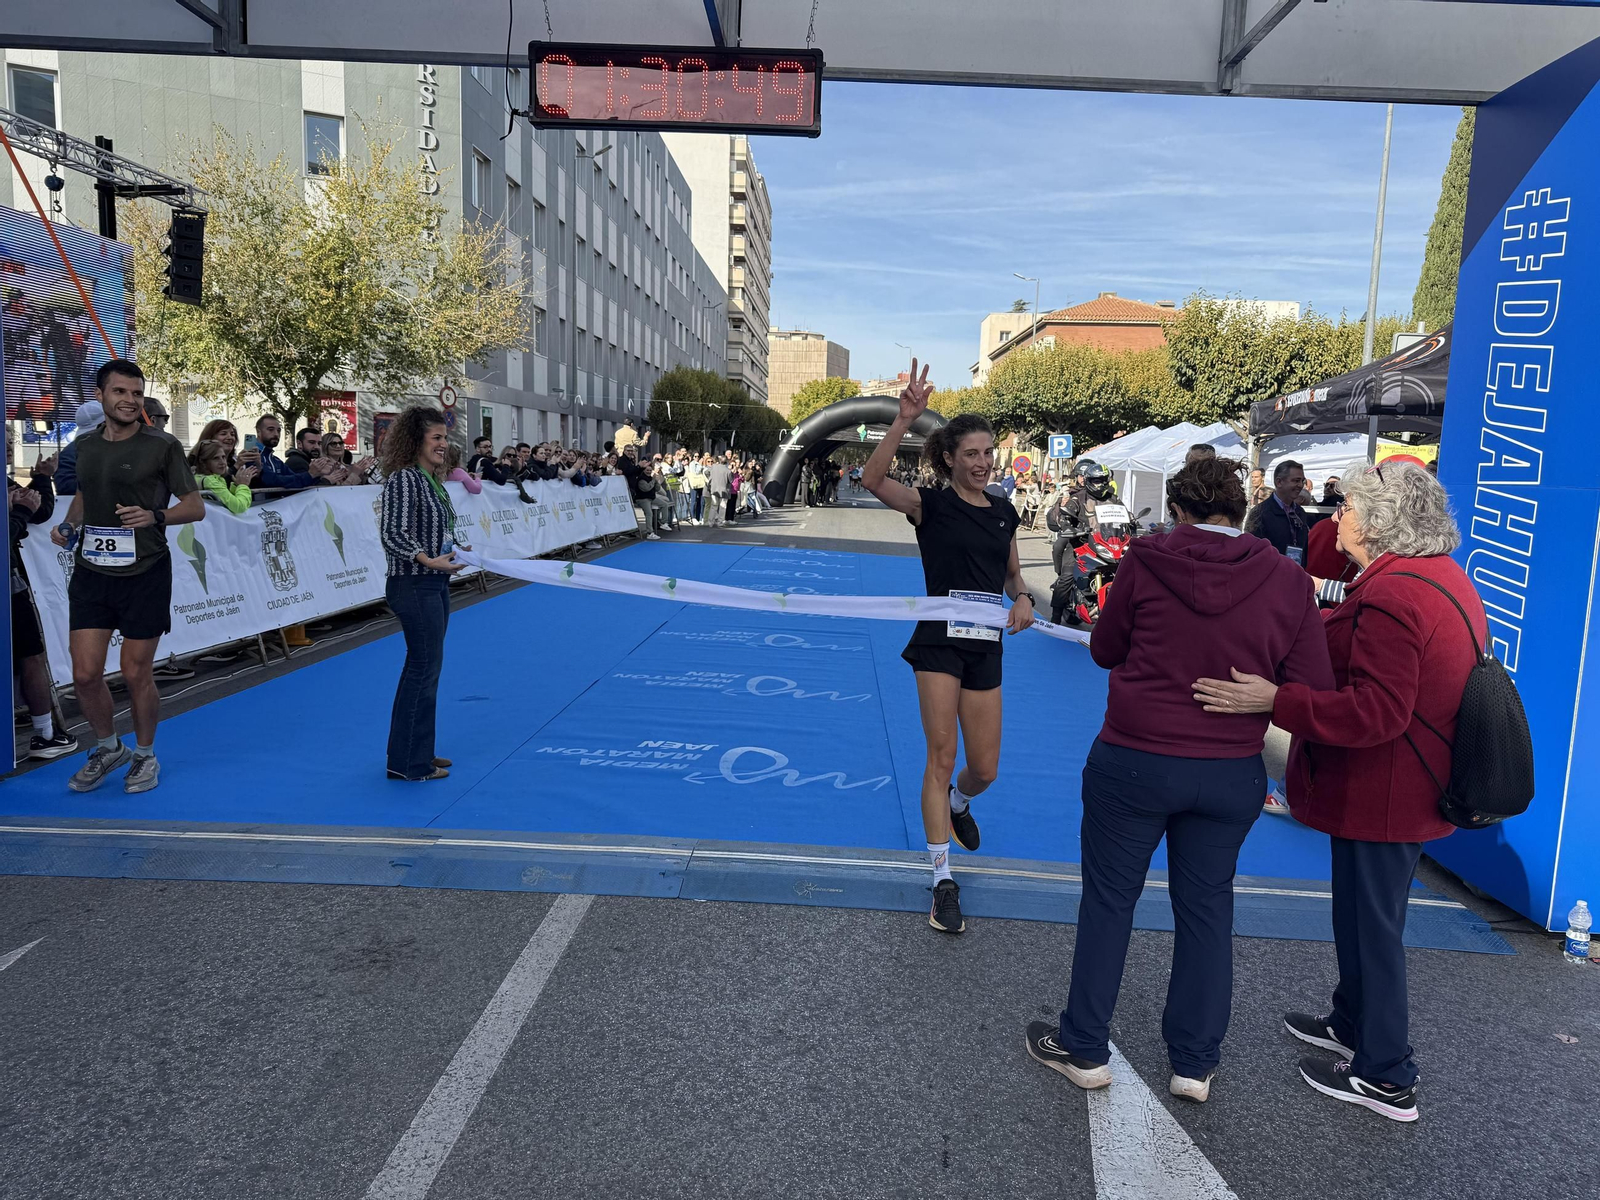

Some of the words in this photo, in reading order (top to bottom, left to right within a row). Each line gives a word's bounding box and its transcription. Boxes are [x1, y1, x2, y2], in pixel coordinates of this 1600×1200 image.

[1465, 187, 1571, 678] #DEJAHUE
[1053, 438, 1067, 455] P
[94, 538, 117, 552] 28
[173, 599, 206, 614] Patronato
[206, 594, 235, 608] Municipal
[237, 593, 245, 602] de
[267, 597, 291, 610] CIUDAD
[290, 594, 300, 604] DE
[300, 590, 314, 602] JAÉN
[185, 611, 216, 625] Deportes
[216, 608, 224, 618] de
[225, 605, 240, 616] Jaén
[535, 747, 703, 760] MARATÓN
[637, 740, 719, 751] JAÉN
[579, 757, 690, 770] MEDIA
